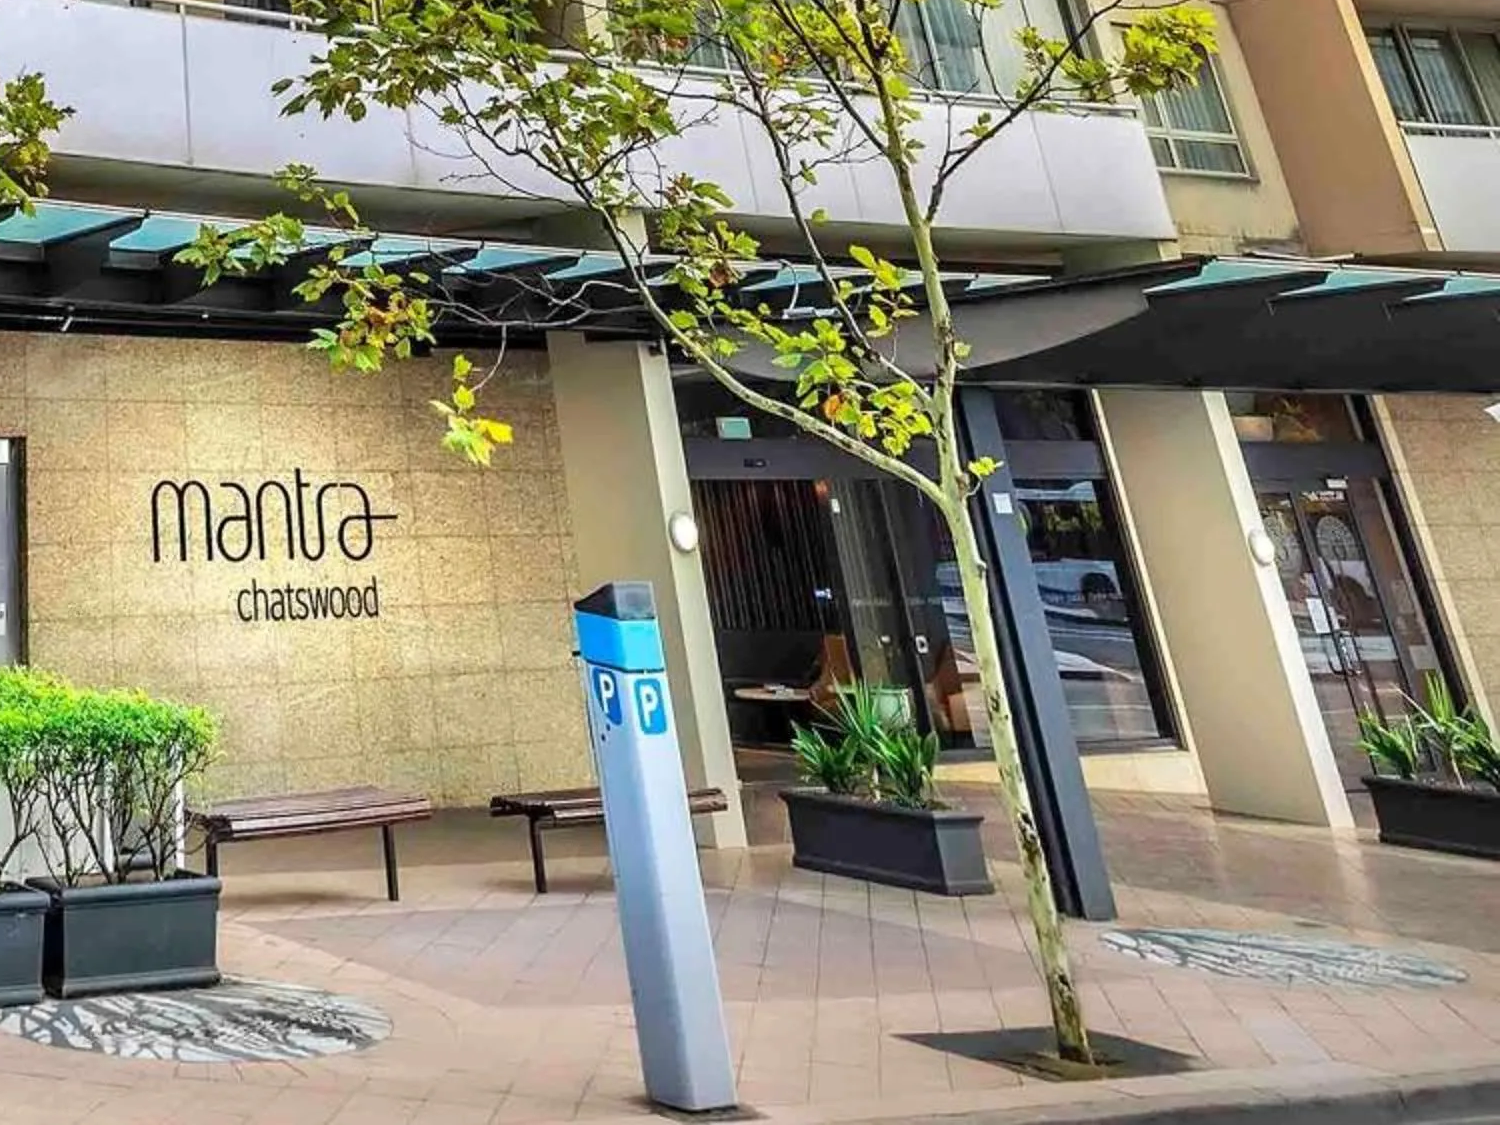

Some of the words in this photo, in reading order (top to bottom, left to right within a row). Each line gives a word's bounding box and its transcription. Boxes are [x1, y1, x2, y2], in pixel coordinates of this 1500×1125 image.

[151, 467, 398, 563] mantra
[236, 575, 379, 622] chatswood
[599, 673, 615, 714] P
[639, 683, 658, 728] P
